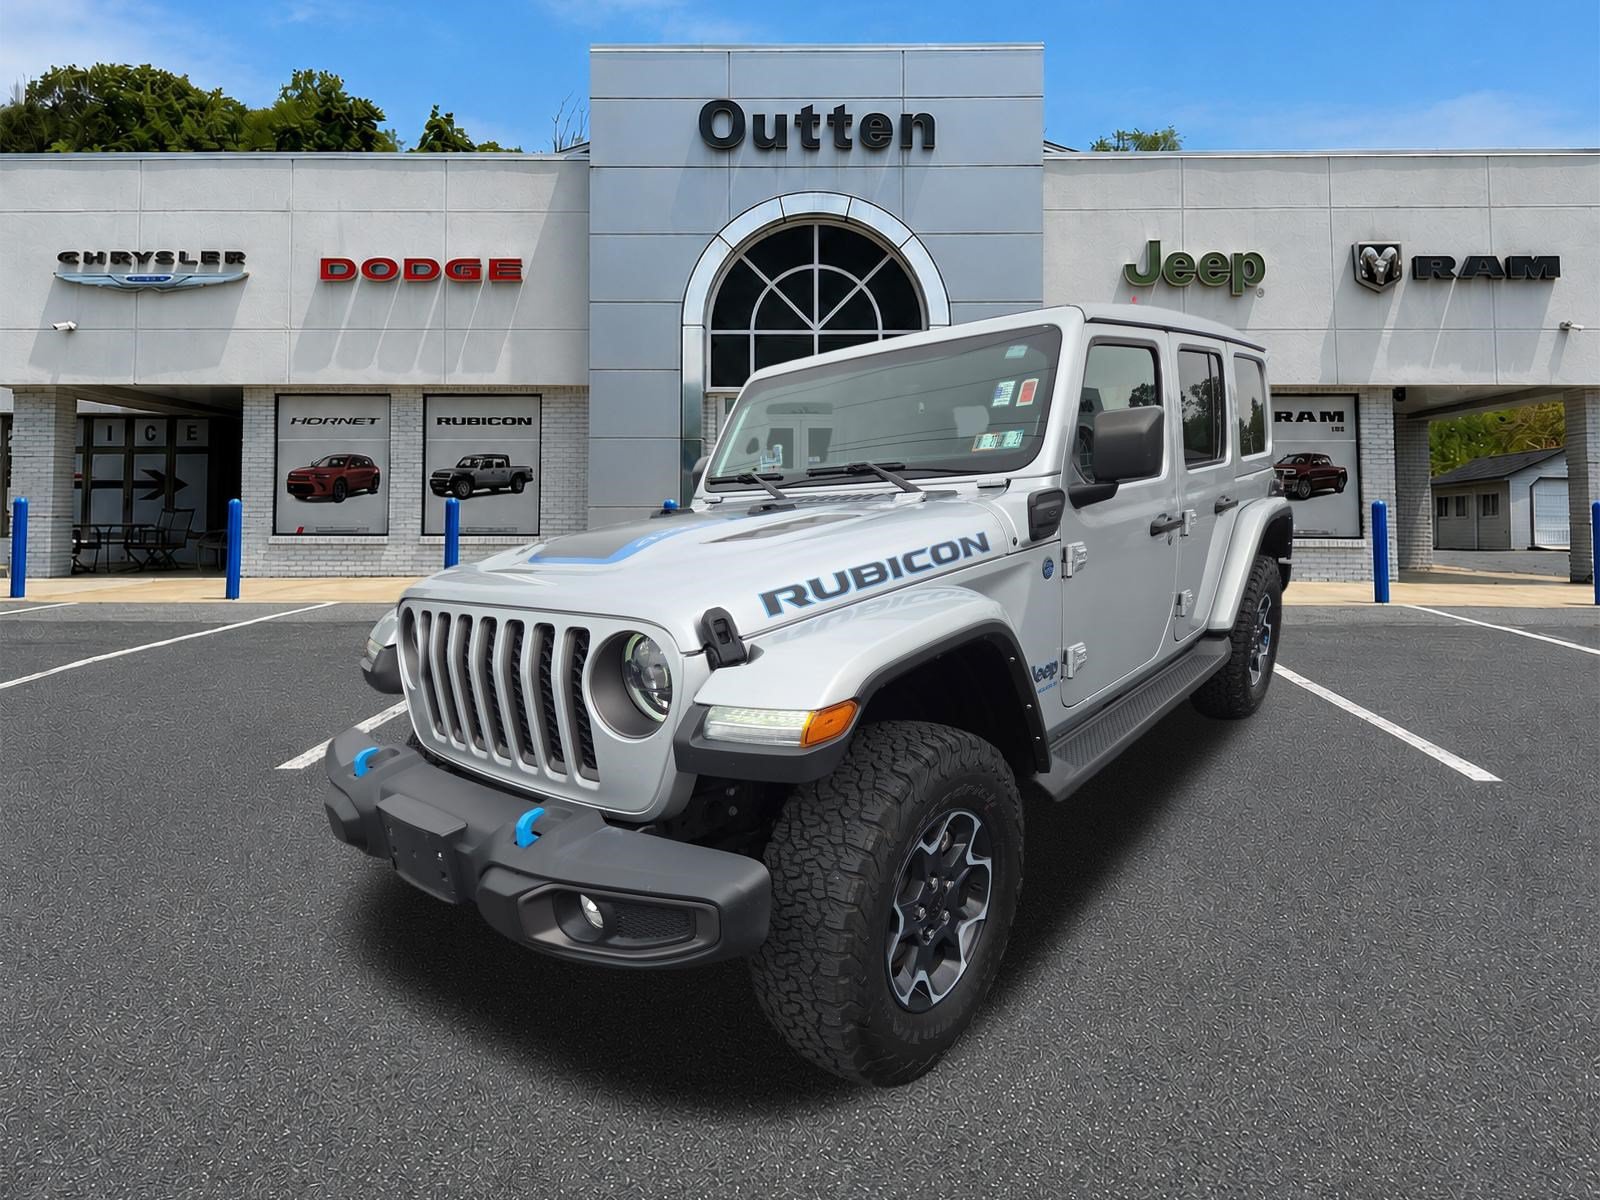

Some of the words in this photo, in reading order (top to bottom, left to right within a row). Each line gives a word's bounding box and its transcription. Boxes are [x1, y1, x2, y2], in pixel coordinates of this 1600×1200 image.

[699, 99, 936, 149] Outten
[57, 251, 247, 265] CHRYSLER
[320, 257, 523, 282] DODGE
[1124, 240, 1266, 296] Jeep
[1411, 255, 1561, 280] RAM
[290, 417, 381, 426] HORNET
[436, 416, 533, 426] RUBICON
[1274, 411, 1345, 423] RAM
[758, 531, 991, 618] RUBICON
